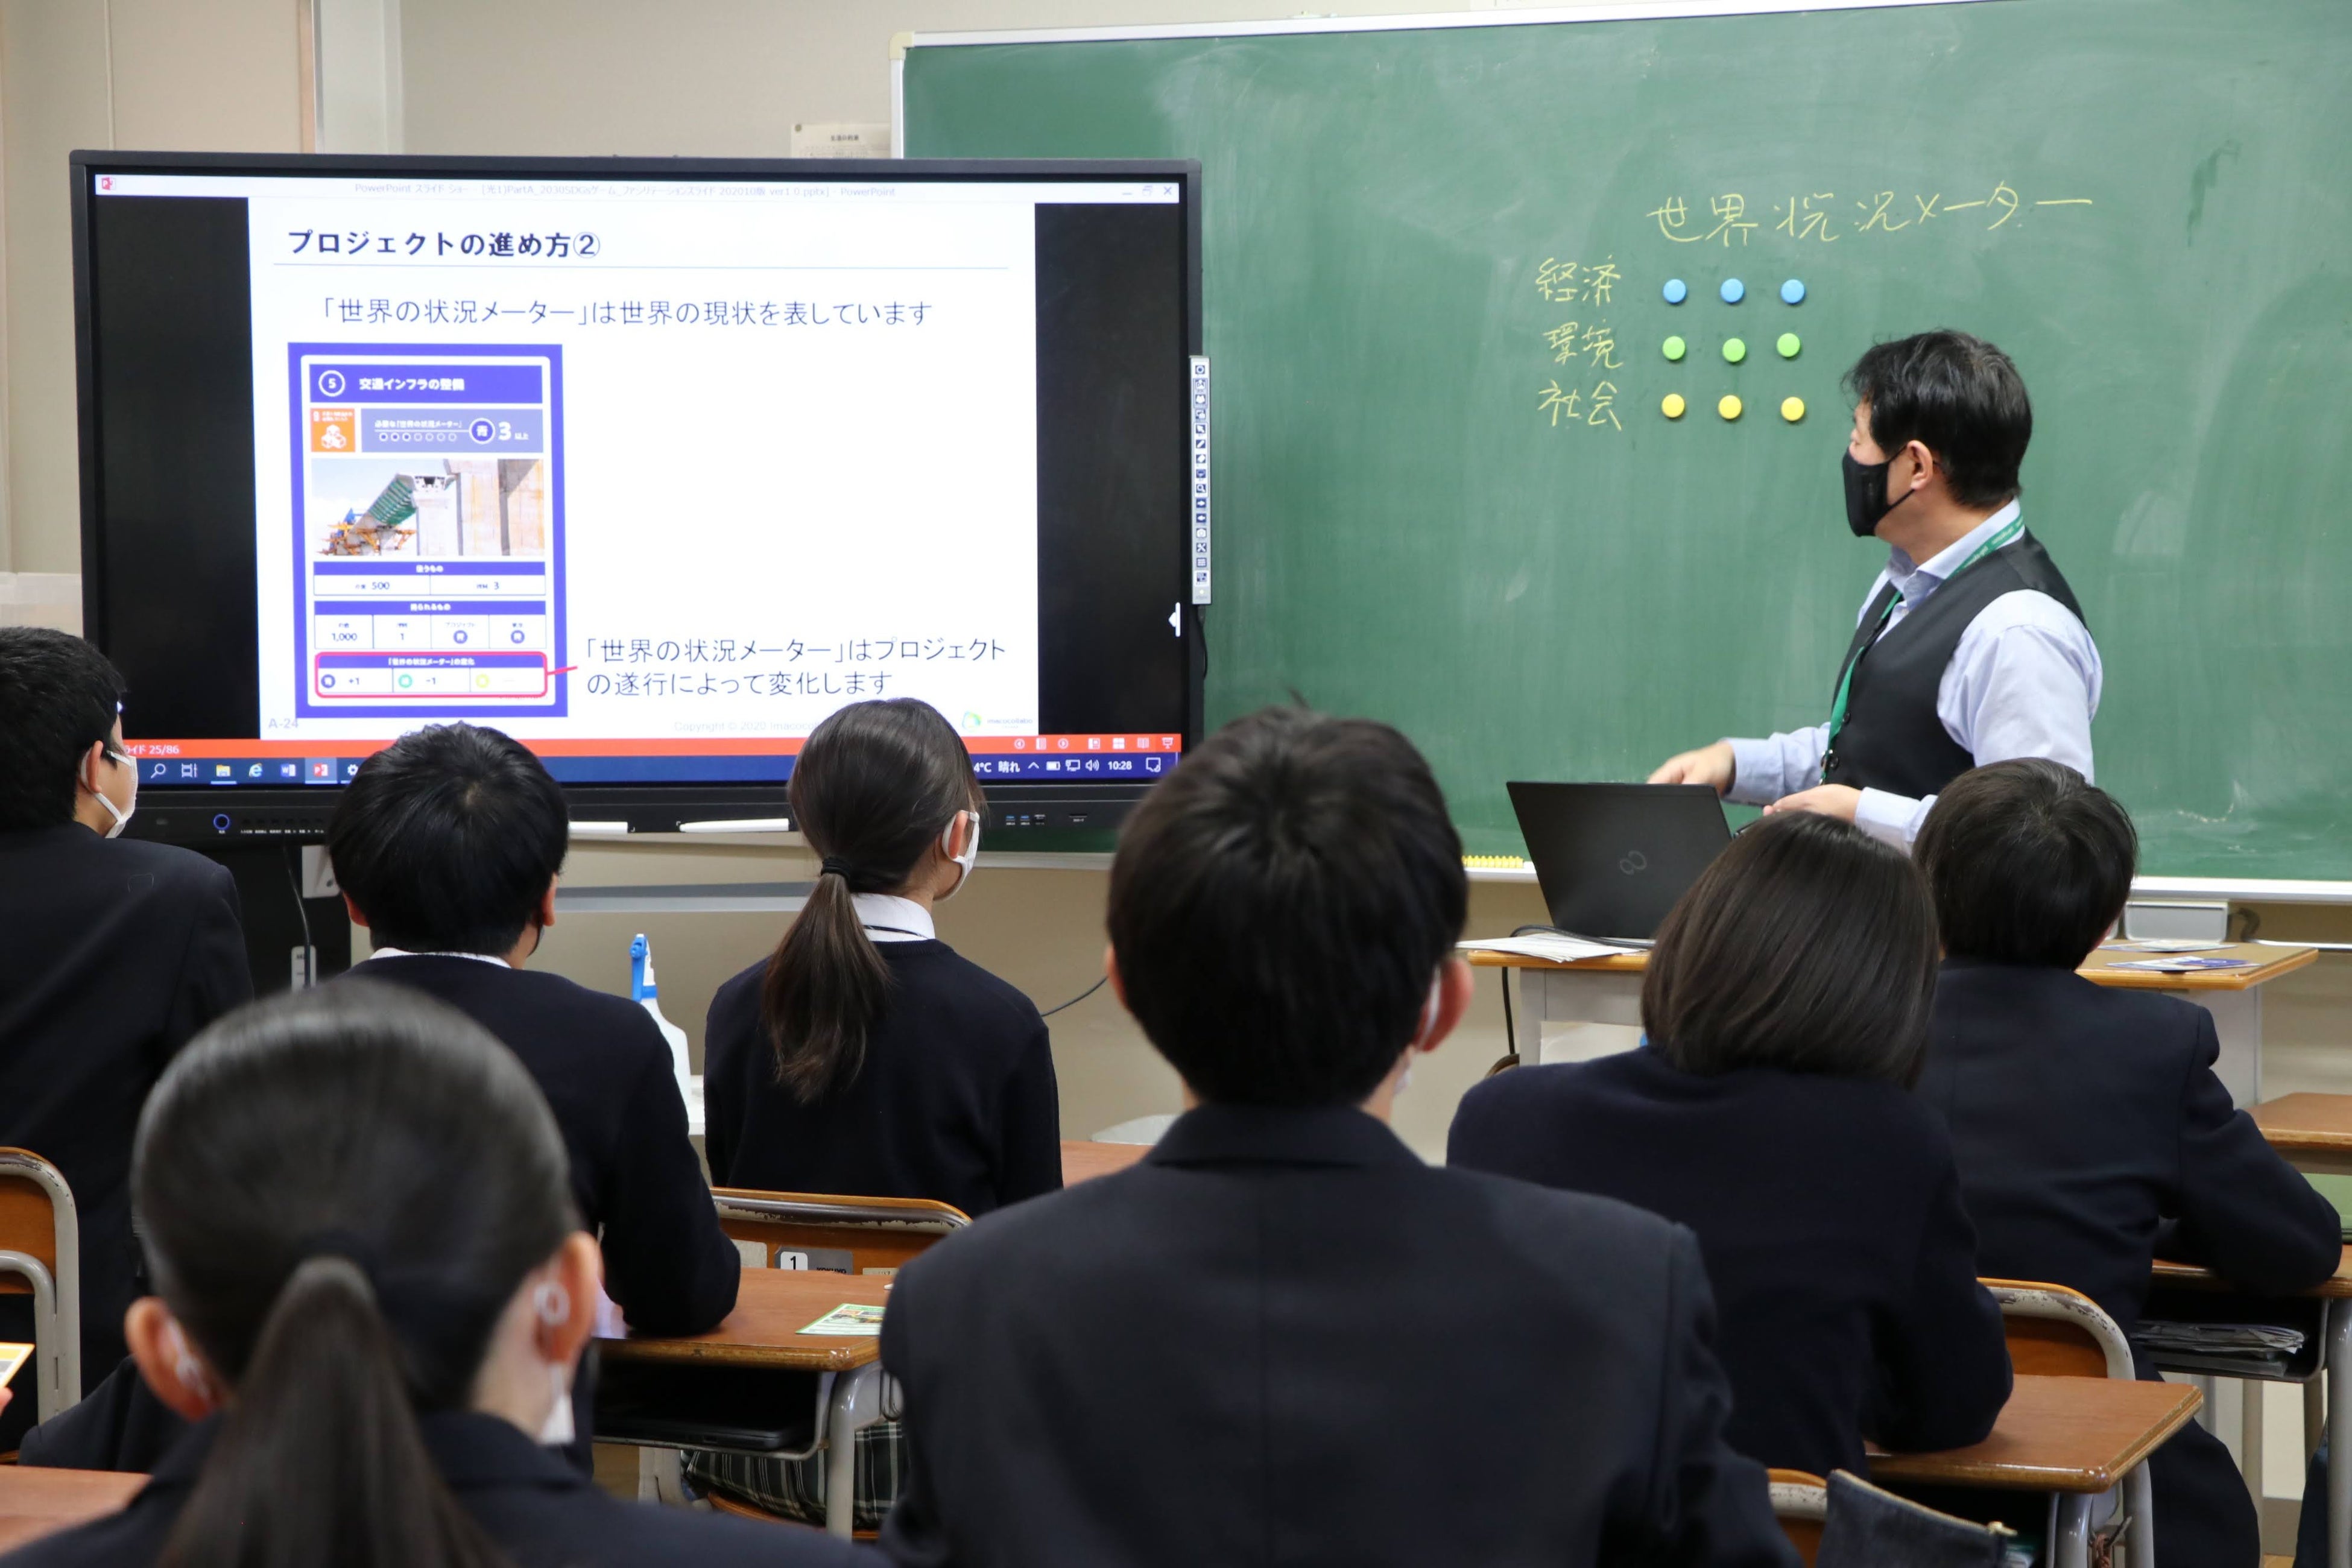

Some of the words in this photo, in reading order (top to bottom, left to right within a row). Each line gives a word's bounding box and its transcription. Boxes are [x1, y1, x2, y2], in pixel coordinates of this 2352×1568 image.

[355, 184, 411, 192] PowerPoint
[415, 185, 444, 193] スライド
[841, 188, 896, 197] PowerPoint
[1535, 256, 1622, 306] 経済
[324, 298, 932, 326] 「世界の状況メーター」は世界の現状を表しています
[1543, 319, 1623, 369] 環境
[1538, 379, 1622, 431] 社会
[498, 422, 512, 441] 3
[371, 581, 391, 590] 500
[494, 581, 500, 590] 3
[331, 633, 358, 642] 1,000
[587, 638, 1006, 663] 「世界の状況メーター」はプロジェクト
[587, 671, 893, 696] の遂行によって変化します
[268, 718, 299, 729] A-24
[674, 721, 725, 732] Copyright
[741, 721, 767, 730] 2020
[149, 744, 180, 756] 25/86
[997, 761, 1020, 773] 晴れ
[1108, 760, 1133, 770] 10:28
[789, 1256, 797, 1270] 1
